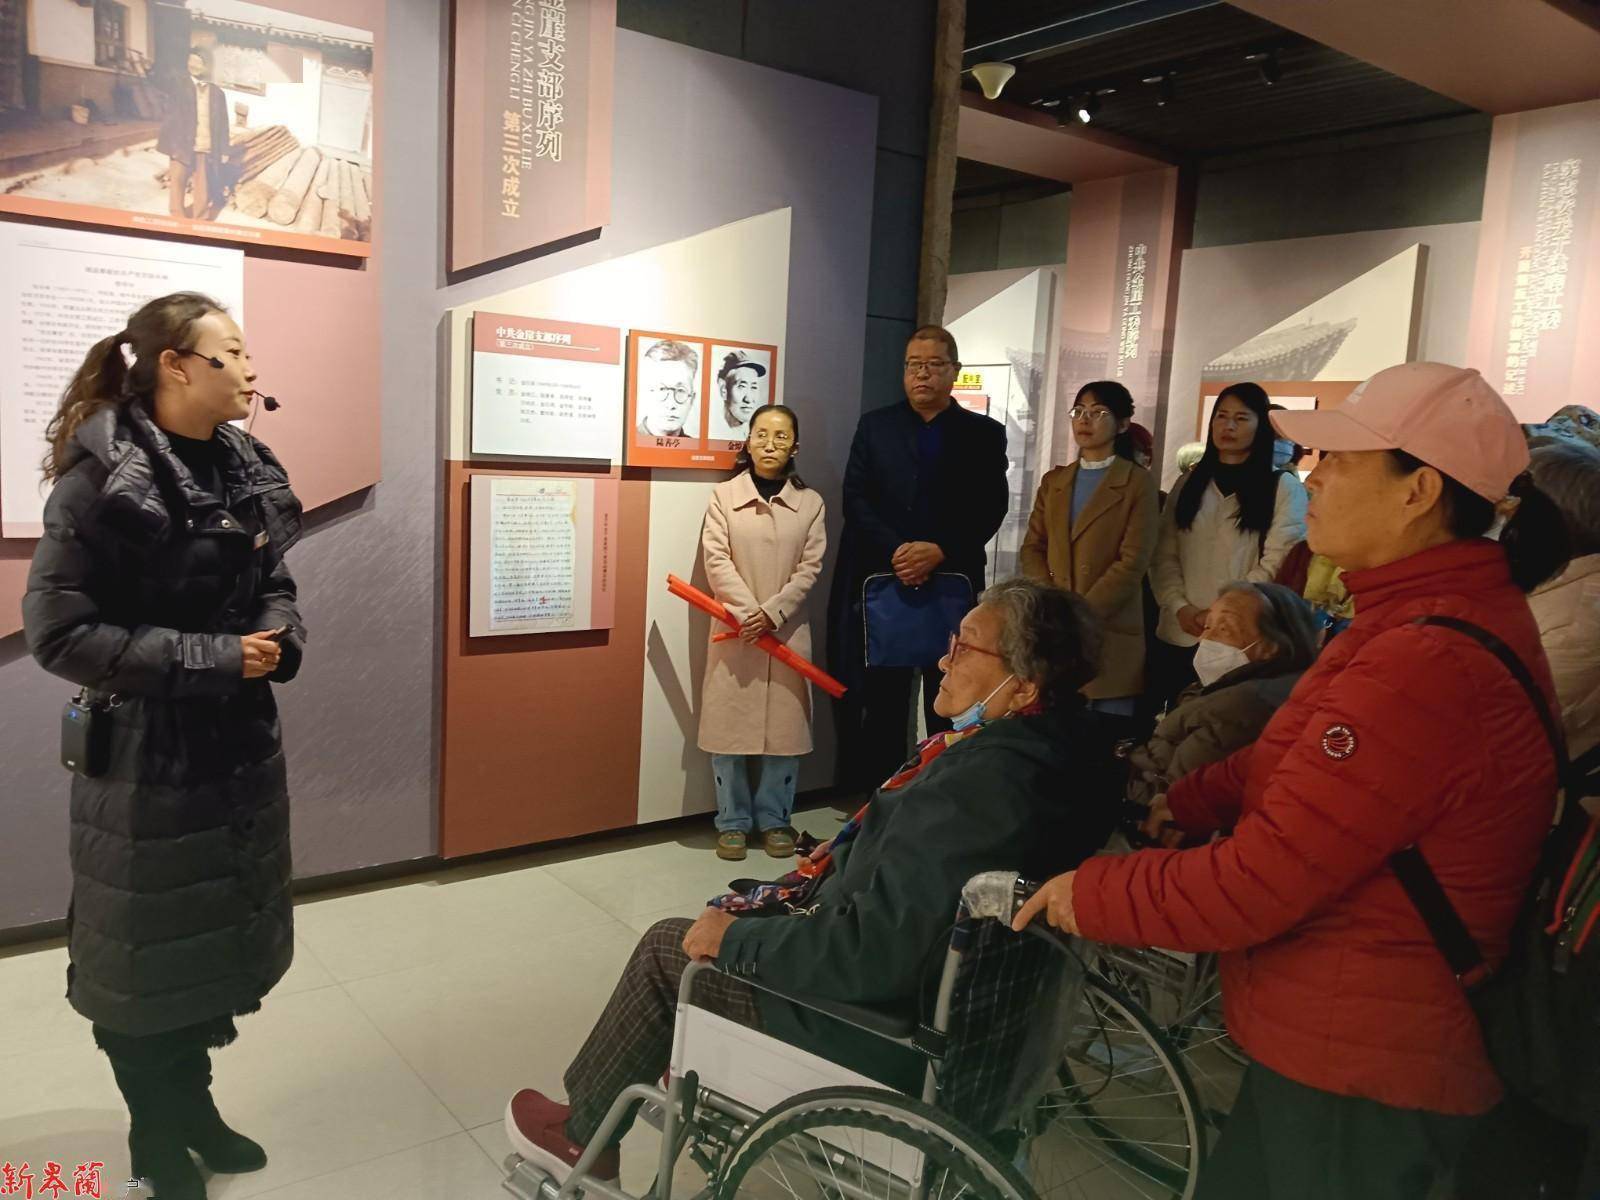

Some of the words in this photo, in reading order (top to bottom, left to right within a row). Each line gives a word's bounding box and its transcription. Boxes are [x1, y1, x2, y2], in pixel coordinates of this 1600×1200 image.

[511, 12, 522, 28] CI
[524, 19, 535, 40] JIN
[510, 31, 522, 84] CHENG
[523, 46, 534, 63] YA
[522, 67, 534, 94] ZHI
[509, 86, 521, 101] LI
[522, 98, 533, 120] BU
[521, 122, 533, 145] XU
[501, 110, 522, 218] 第三次成立
[521, 147, 532, 169] LIE
